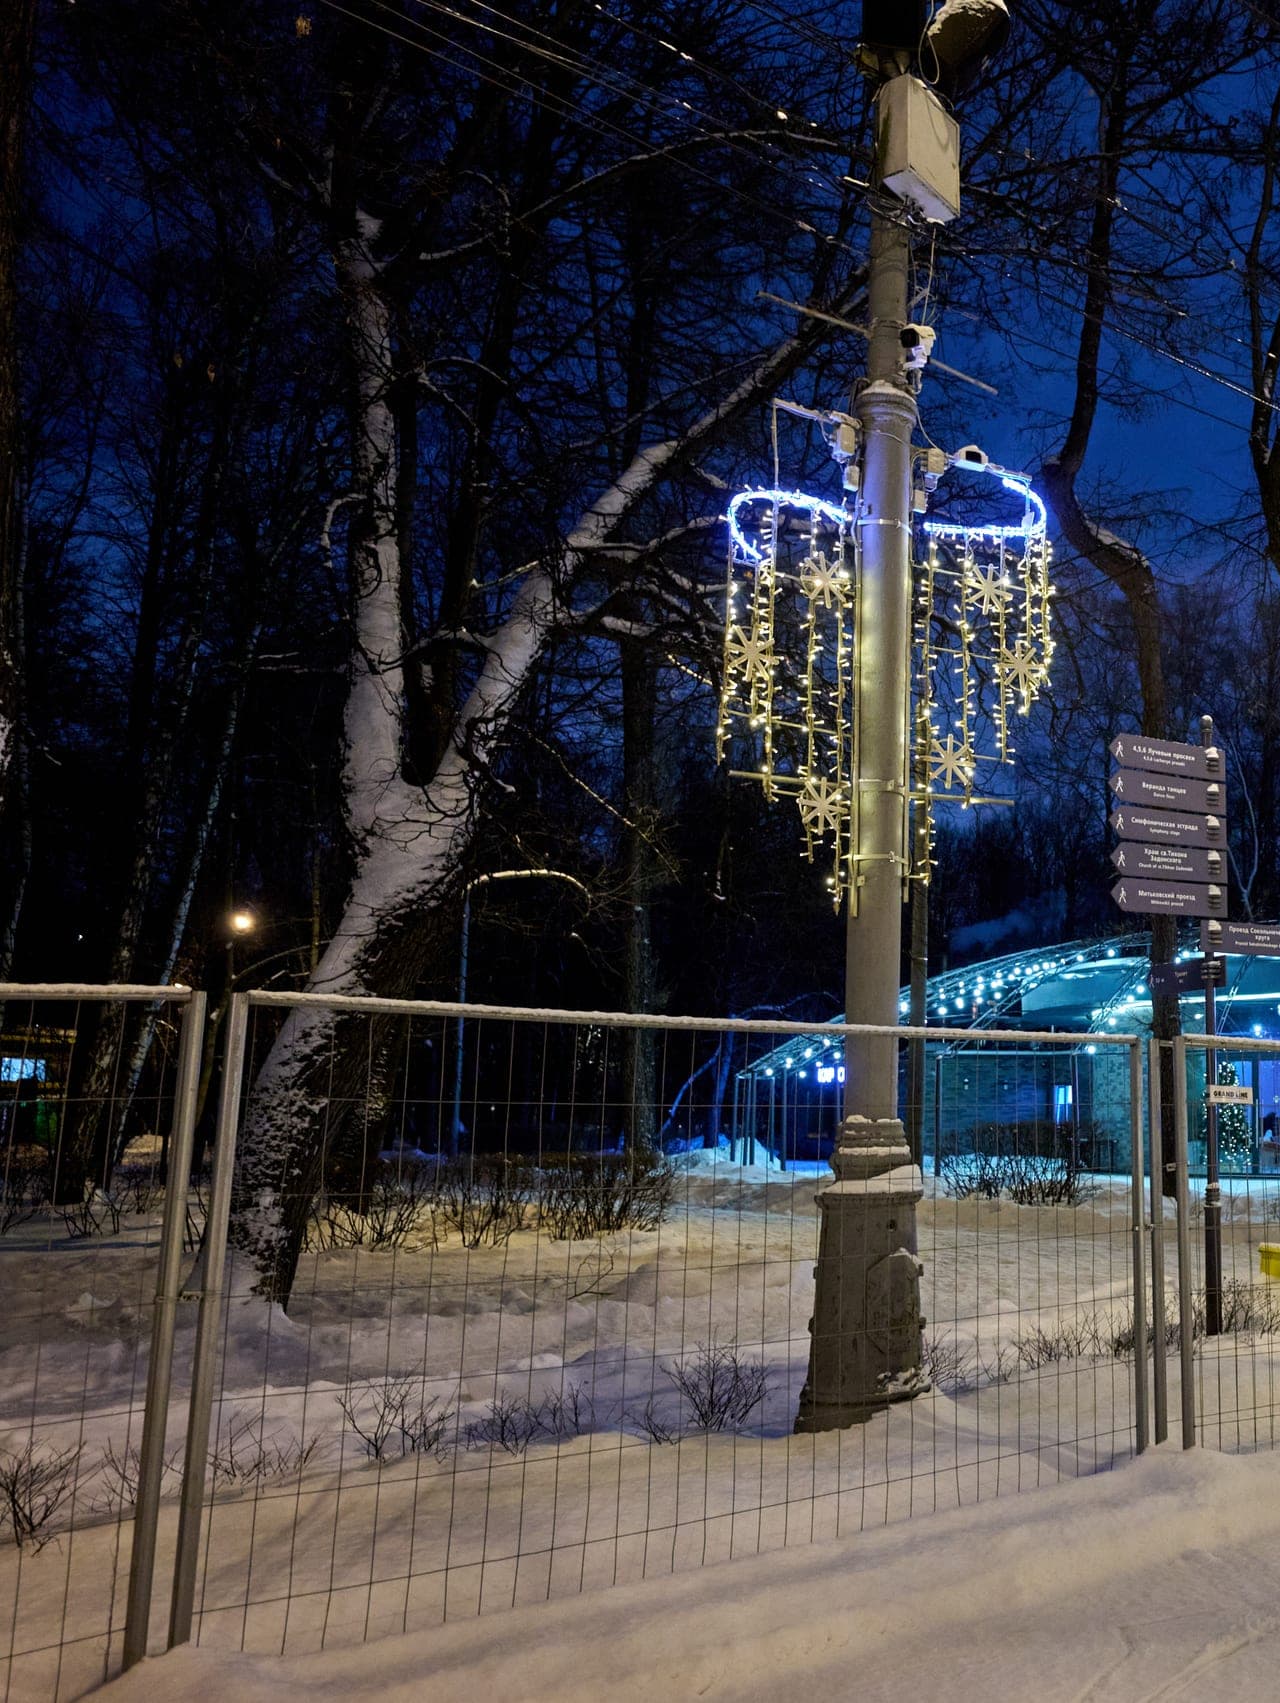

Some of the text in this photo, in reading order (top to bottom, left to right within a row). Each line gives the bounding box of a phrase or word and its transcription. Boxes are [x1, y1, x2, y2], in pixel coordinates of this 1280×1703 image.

[1142, 782, 1186, 794] Веранда танцев
[1131, 816, 1198, 831] Симфоническая эстрада
[1144, 848, 1160, 857] Храм
[1151, 855, 1181, 863] Задонского
[1138, 890, 1196, 901] Митьковский проезд
[1229, 926, 1249, 934] Проезд
